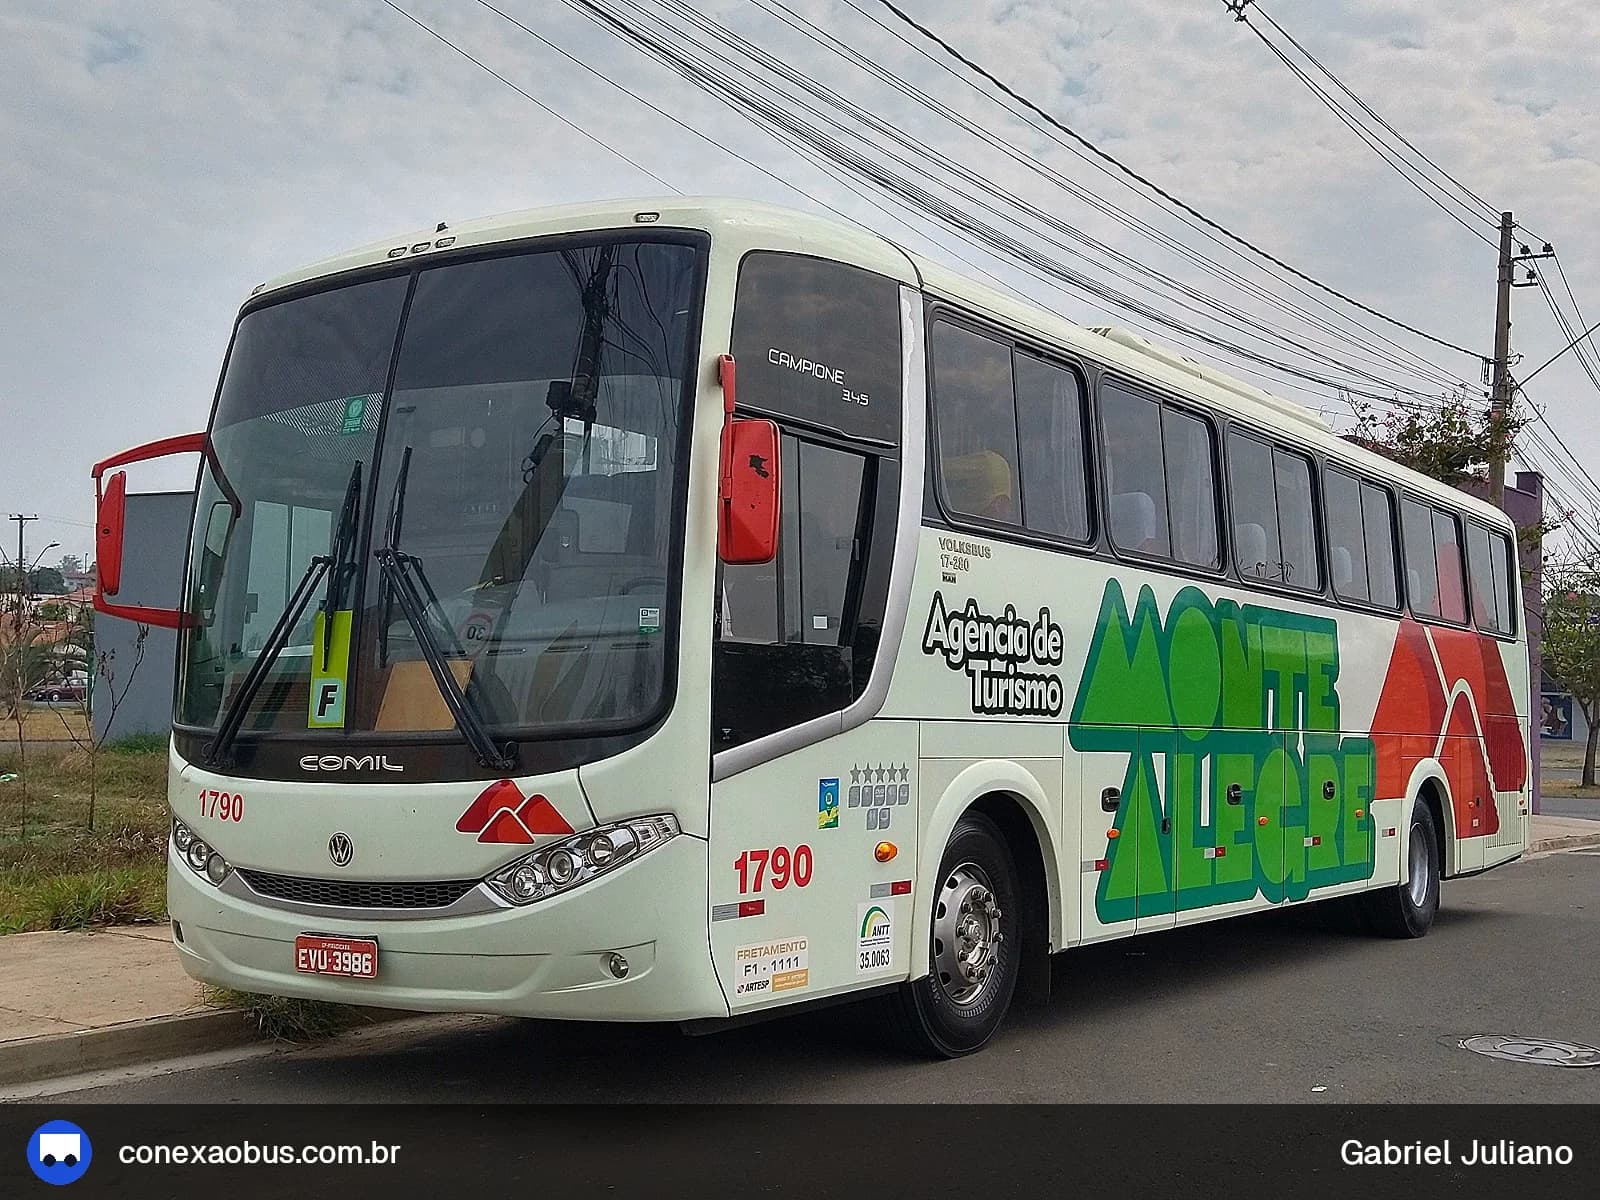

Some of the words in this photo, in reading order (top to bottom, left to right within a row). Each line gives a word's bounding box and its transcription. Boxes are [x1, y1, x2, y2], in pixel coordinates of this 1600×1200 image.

[768, 348, 845, 385] CAMPIONE
[842, 389, 869, 406] 345
[938, 537, 991, 559] VOLKSBUS
[924, 593, 1029, 667] Agência
[1032, 609, 1062, 663] de
[1072, 580, 1340, 750] MONTE
[967, 658, 1062, 714] Turismo
[318, 684, 338, 717] F
[299, 754, 404, 773] COMIL
[198, 789, 244, 824] 1790
[1098, 743, 1374, 915] ALEGRE
[734, 844, 814, 894] 1790
[872, 924, 890, 937] ANTT
[737, 940, 807, 960] FRETAMENTO
[859, 949, 890, 970] 35.0063
[744, 963, 758, 977] F1
[771, 956, 799, 971] 1111
[745, 980, 769, 992] ARTESP
